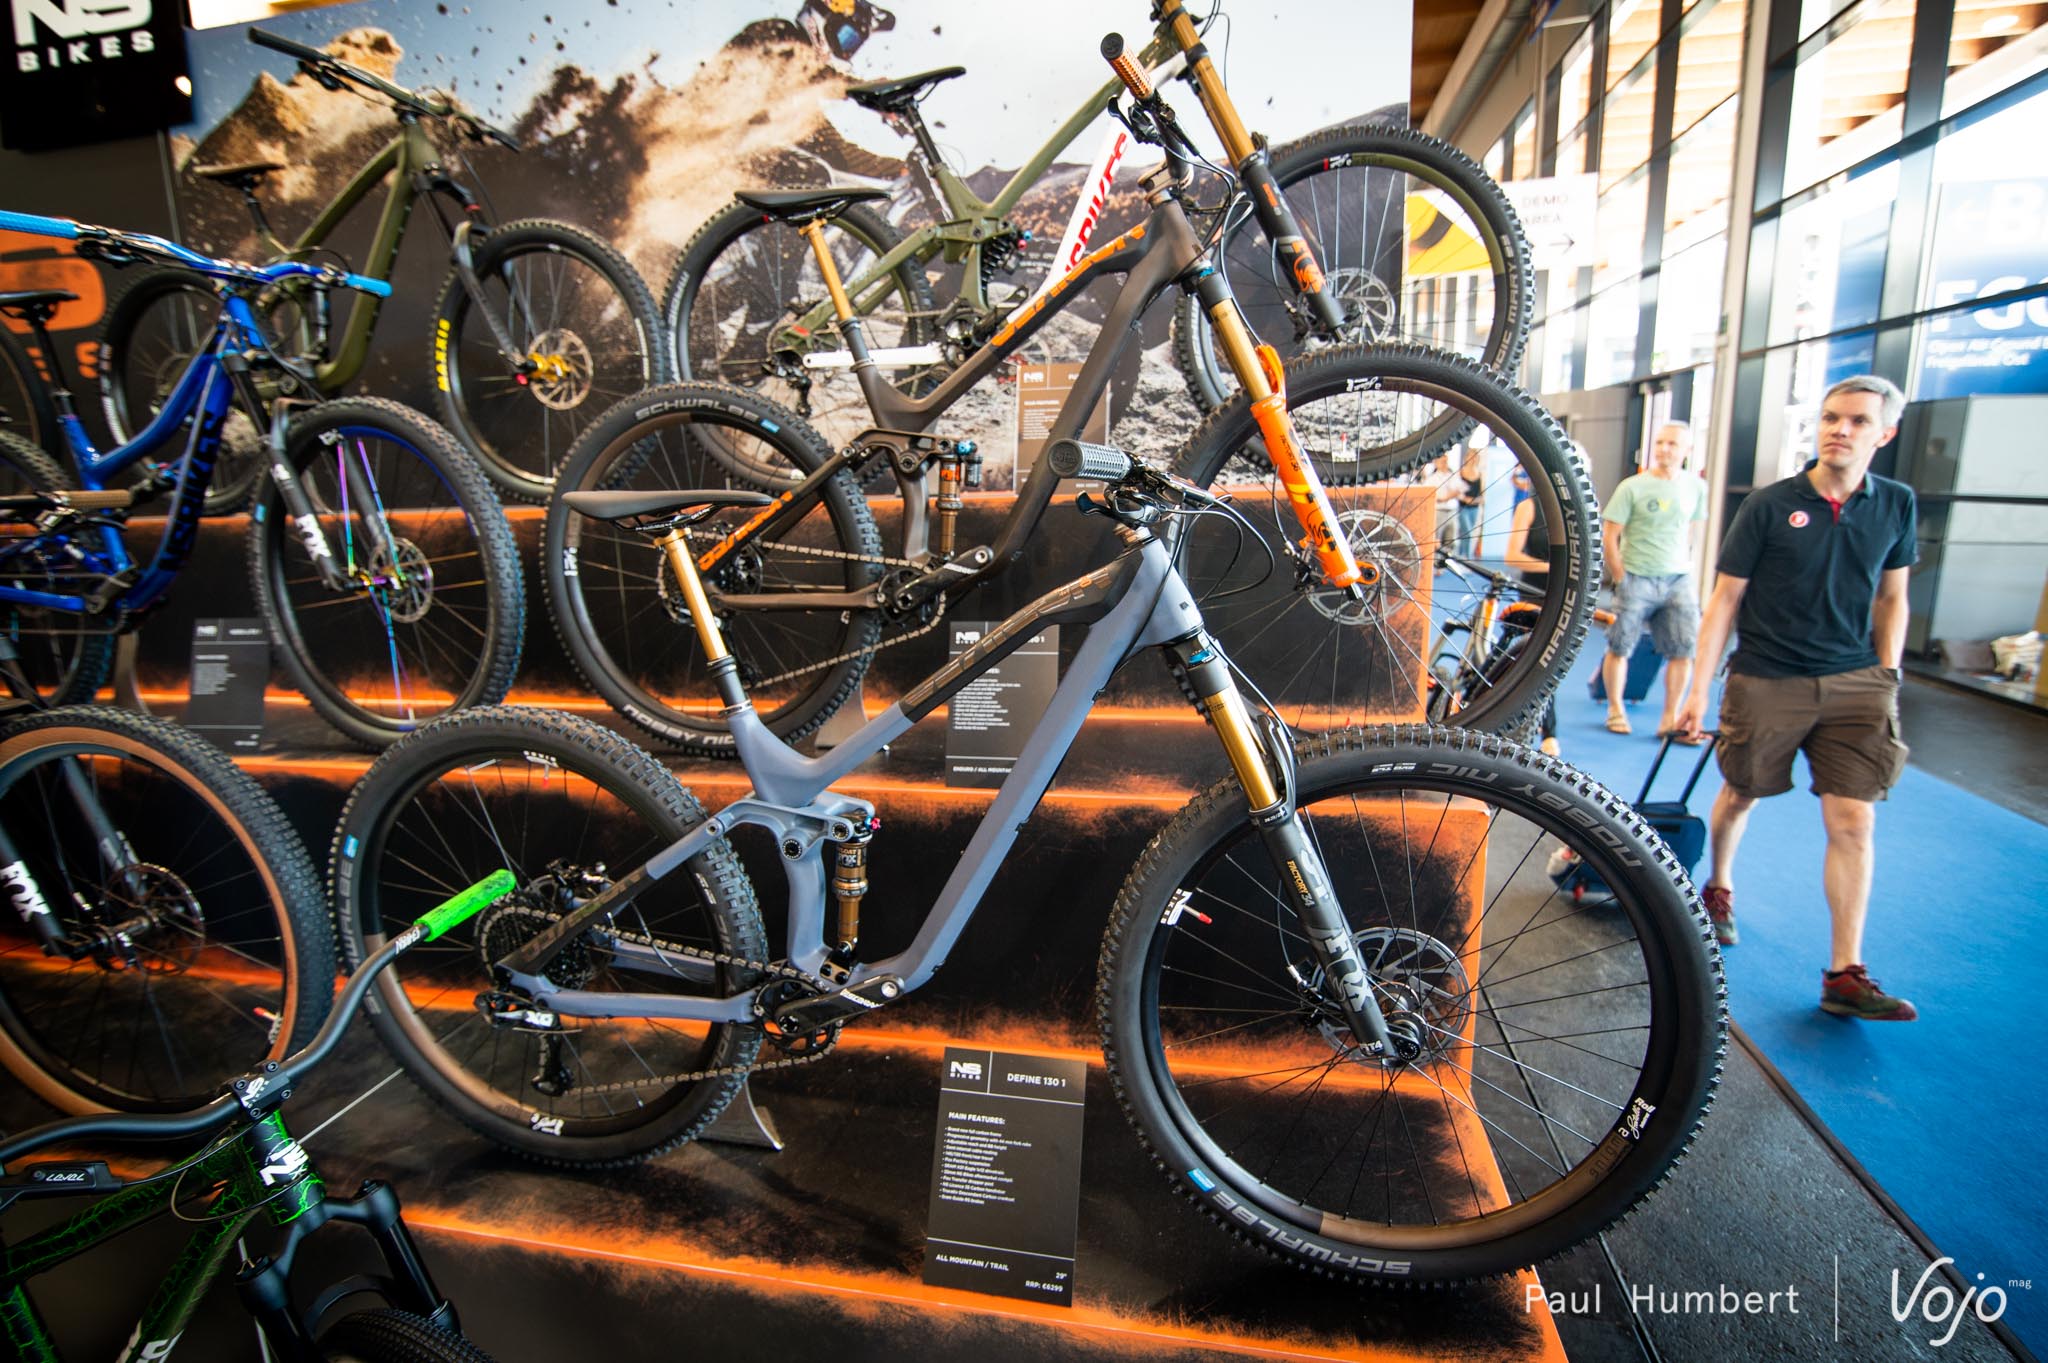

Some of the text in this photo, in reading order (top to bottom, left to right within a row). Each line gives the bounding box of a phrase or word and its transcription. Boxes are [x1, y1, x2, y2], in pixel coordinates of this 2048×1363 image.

[17, 30, 155, 72] BIKES
[635, 399, 760, 421] SCHWALBE
[1539, 506, 1583, 668] MAGIC MARY
[623, 703, 696, 742] NOBBY
[1427, 763, 1498, 783] NIC
[1511, 784, 1643, 867] NOBBY
[1287, 860, 1314, 907] FACTORY 34
[950, 1061, 982, 1075] NS
[1007, 1073, 1066, 1088] DEFINE 130 1
[1634, 1097, 1656, 1113] Roll
[948, 1112, 1006, 1124] MAIN FEATURES:
[1212, 1191, 1412, 1275] SCHWALBE
[936, 1254, 948, 1262] ALL
[949, 1256, 984, 1268] MOUNTAIN
[990, 1262, 1009, 1272] TRAIL
[1026, 1280, 1040, 1288] RRP:
